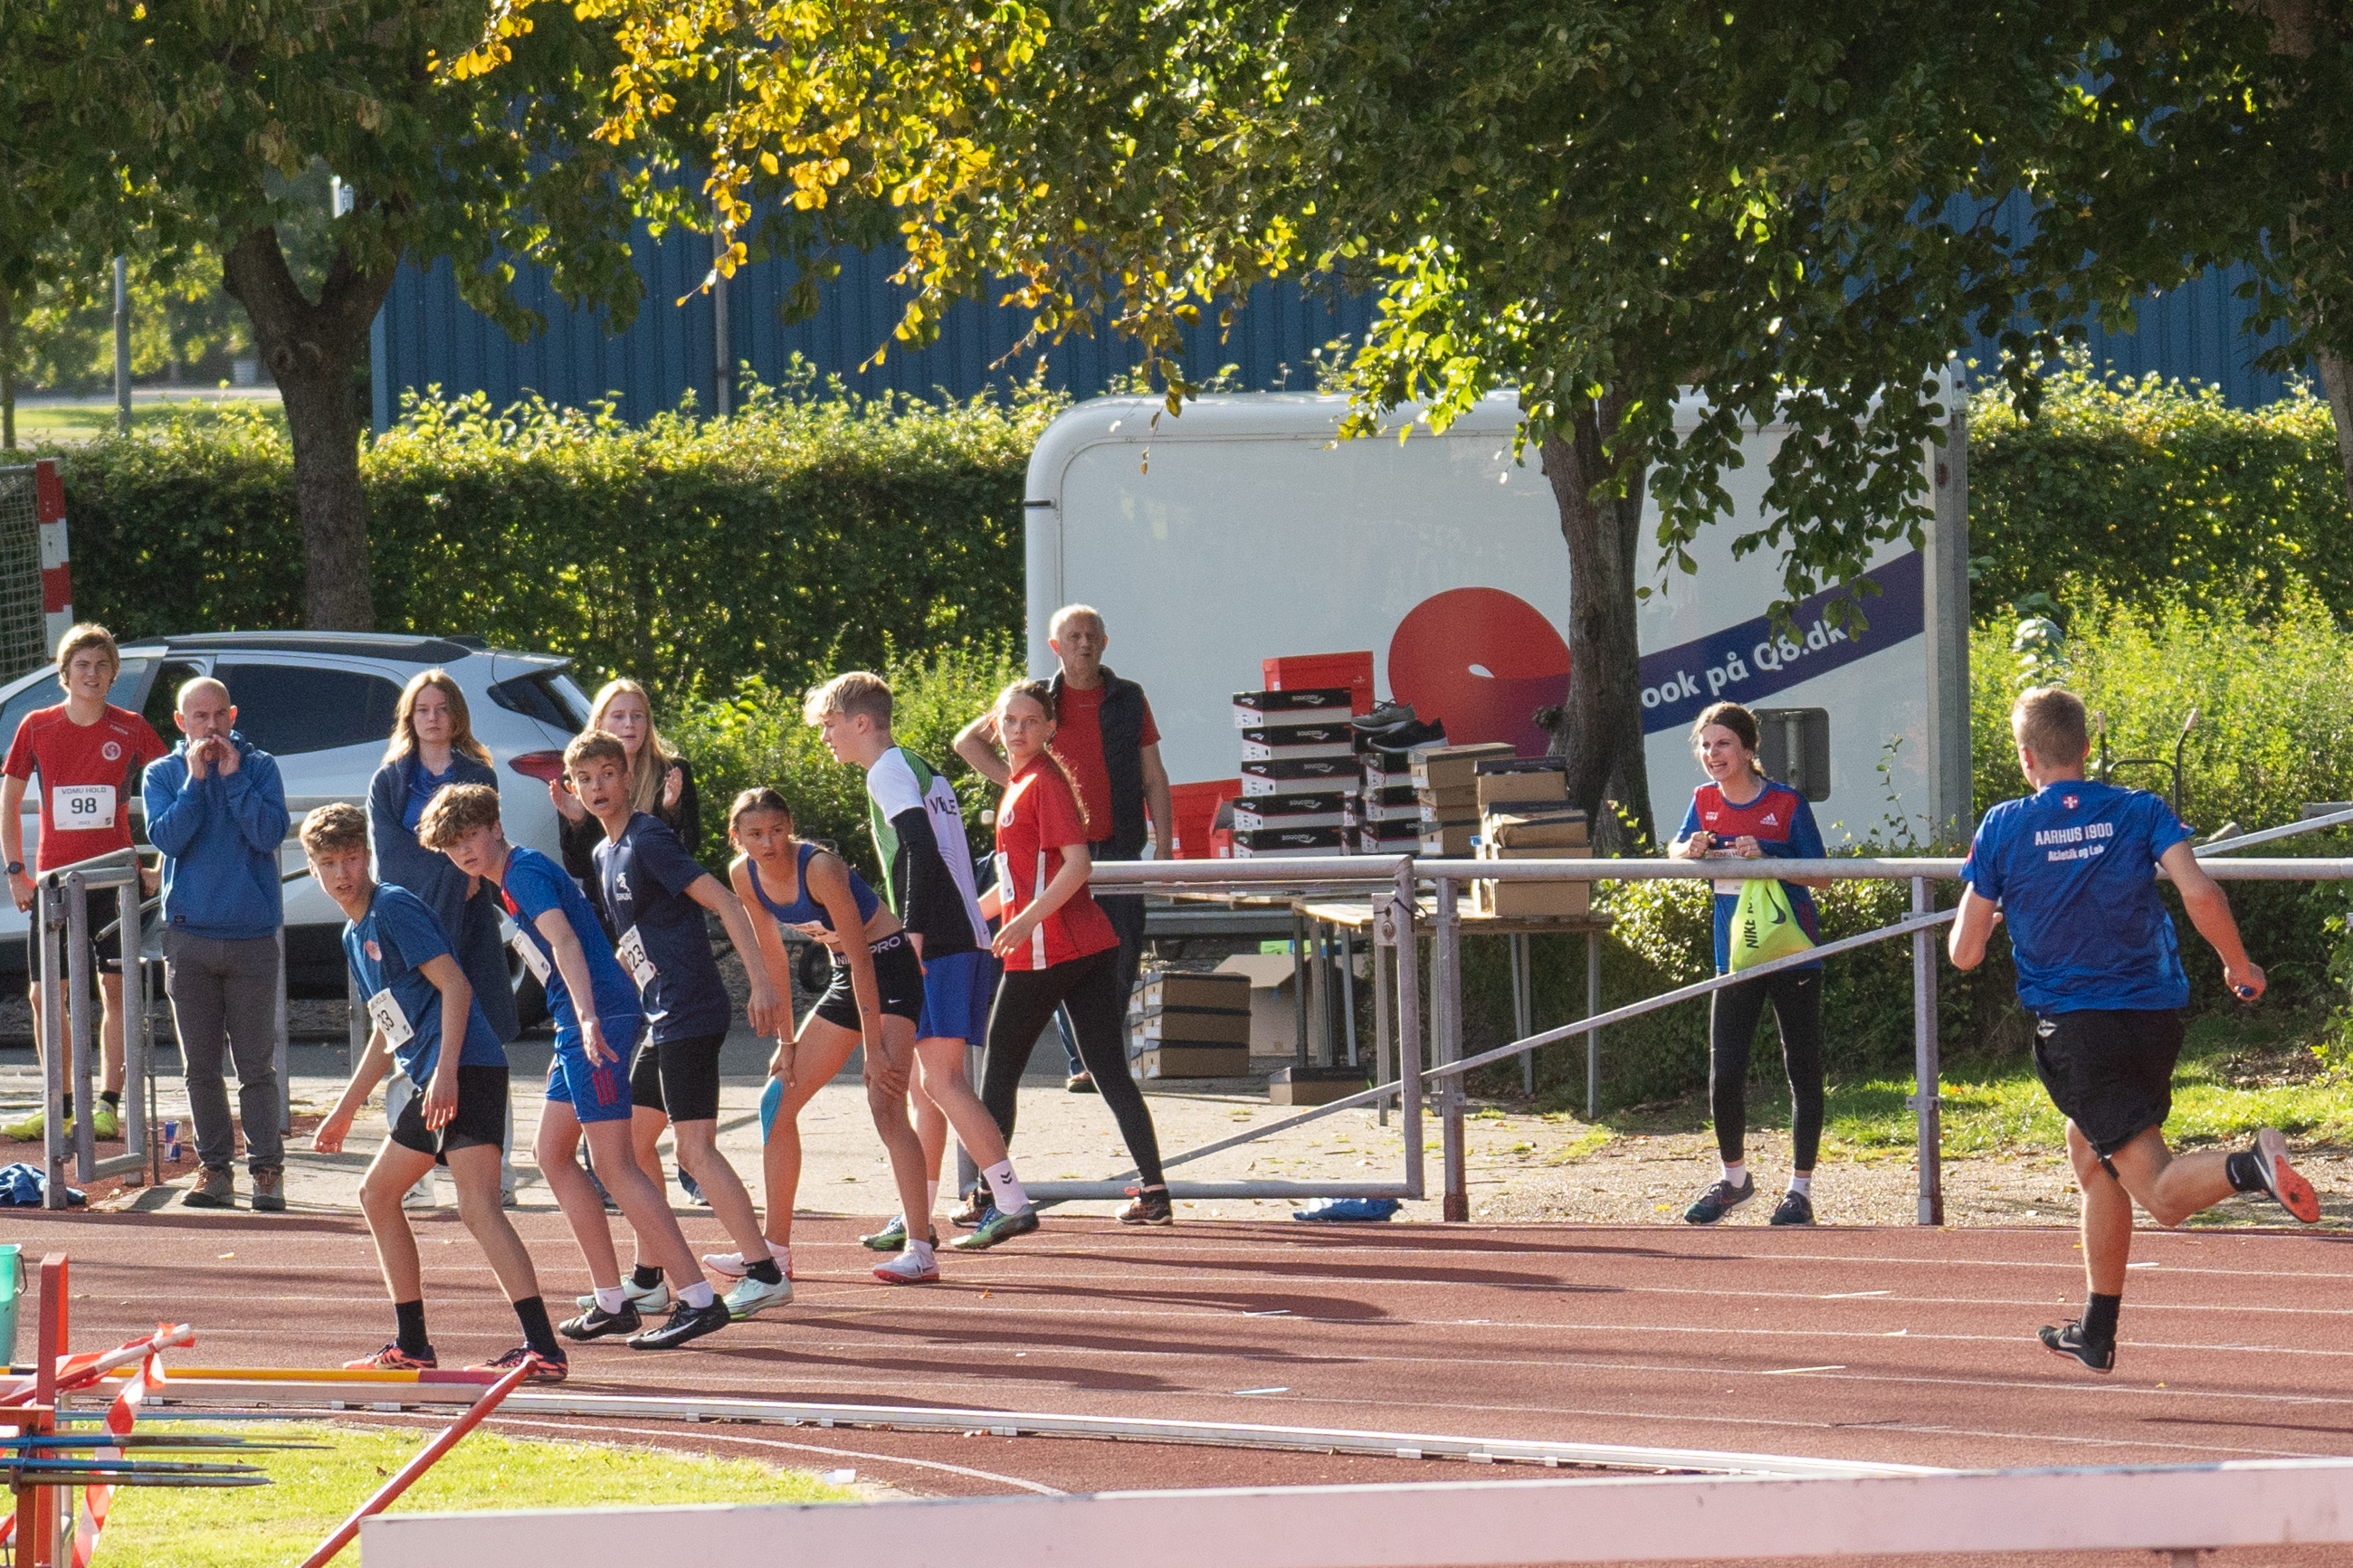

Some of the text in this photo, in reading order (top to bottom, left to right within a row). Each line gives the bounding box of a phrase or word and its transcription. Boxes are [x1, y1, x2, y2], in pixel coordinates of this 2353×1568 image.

[1641, 620, 1848, 708] ook på Q8.dk
[71, 797, 97, 814] 98
[2034, 822, 2113, 846] AARHUS 1900
[2079, 848, 2089, 860] og
[1743, 919, 1759, 948] NIKE
[869, 936, 901, 955] PRO
